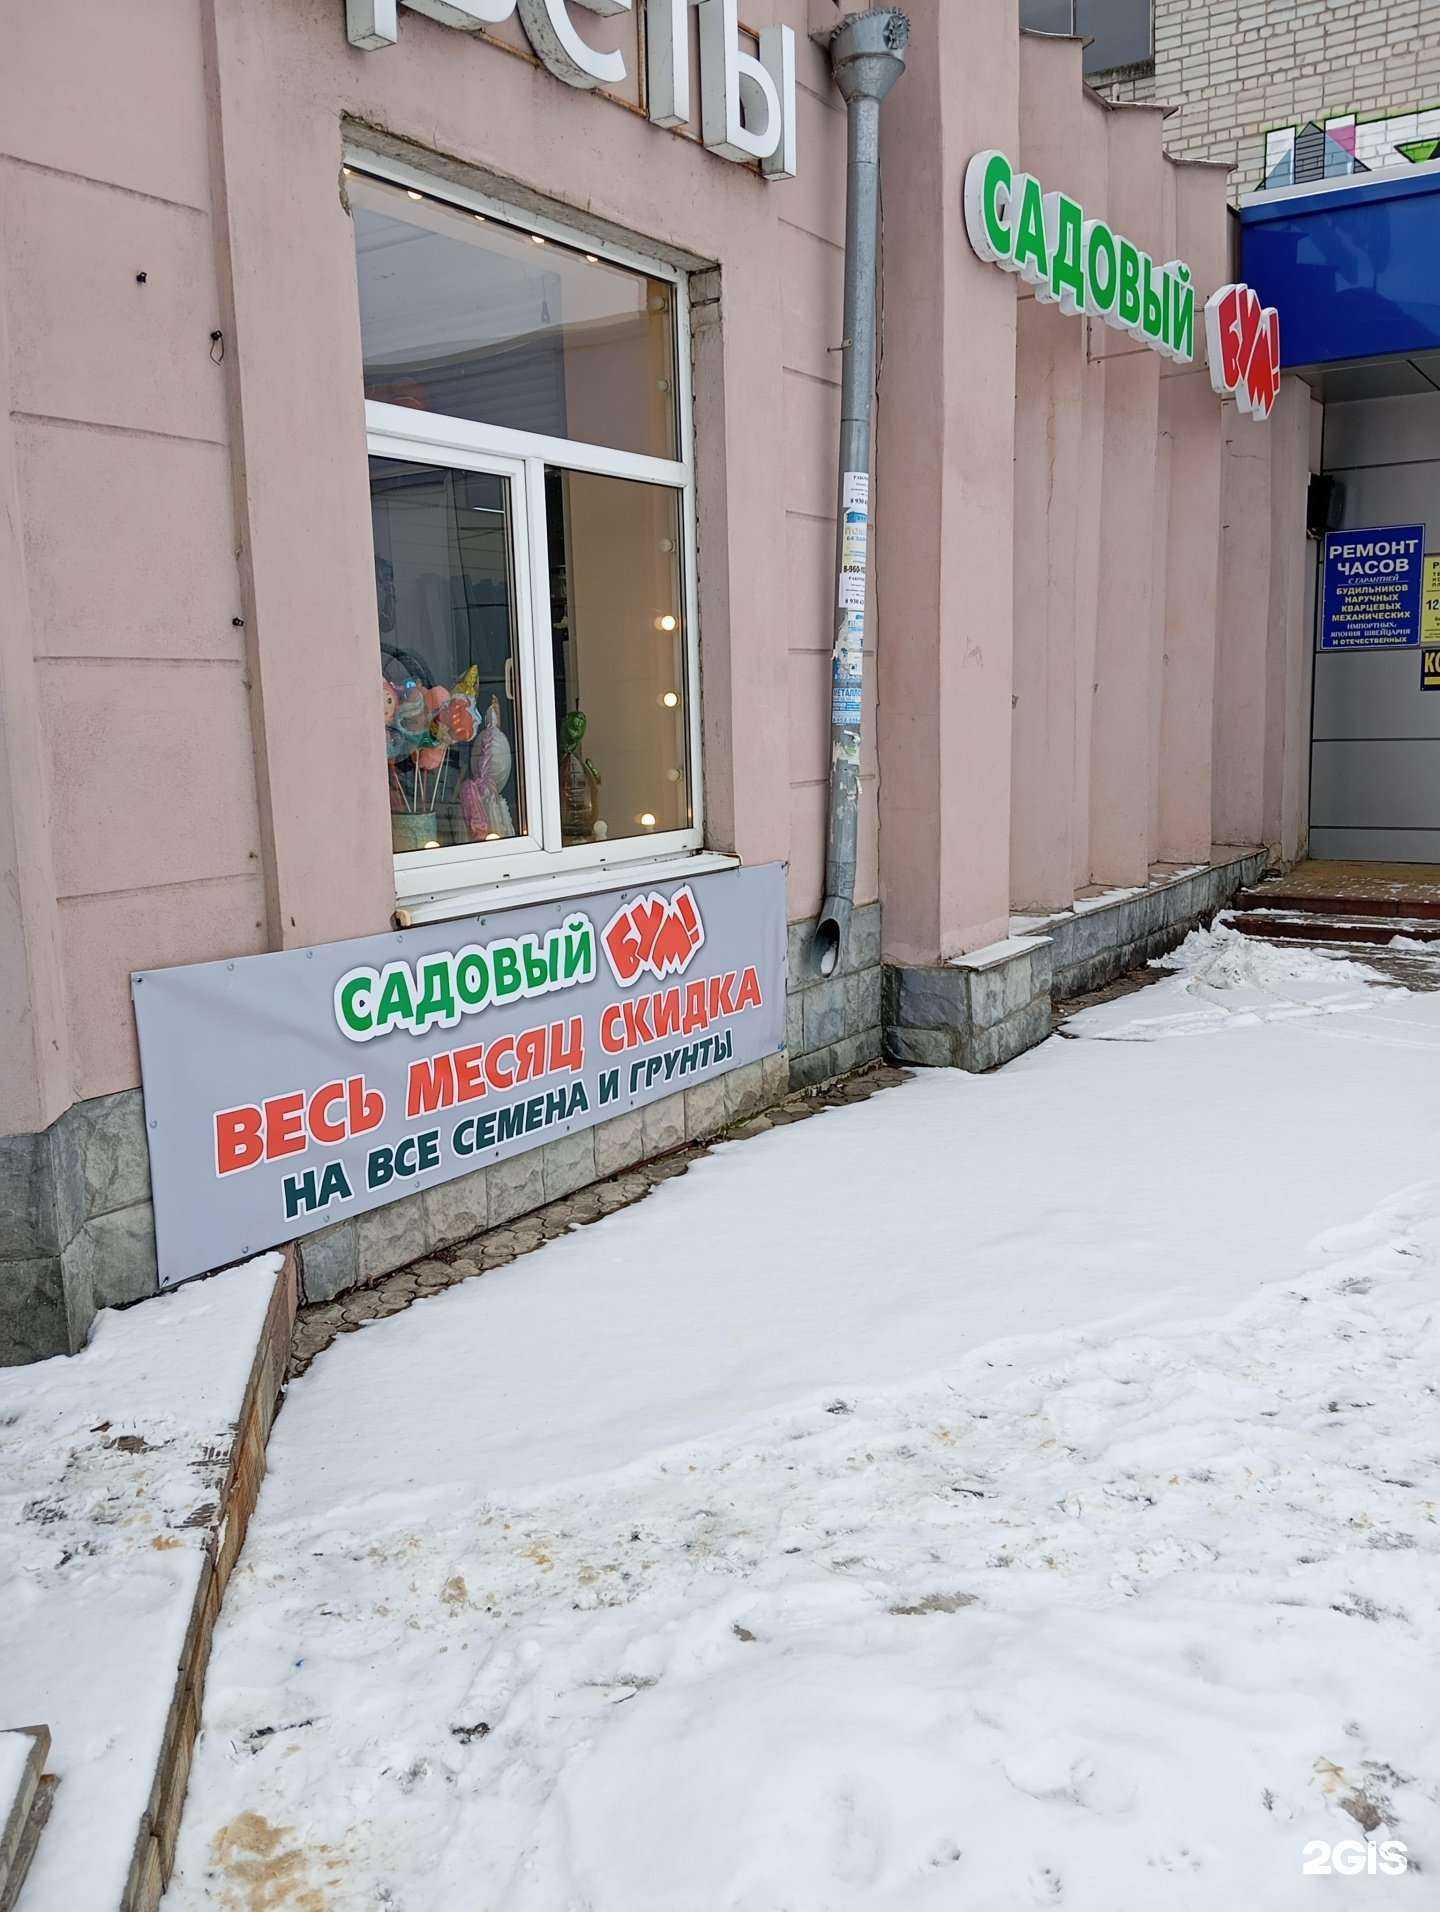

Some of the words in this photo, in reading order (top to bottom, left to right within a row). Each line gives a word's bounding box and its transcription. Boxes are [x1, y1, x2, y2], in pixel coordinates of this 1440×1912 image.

[980, 154, 1194, 359] САДОВЫЙ
[1329, 540, 1418, 559] РЕМОНТ
[1337, 558, 1409, 576] ЧАСОВ
[1336, 584, 1408, 595] БУДИЛЬНИКОВ
[1341, 602, 1402, 613] КВАРЦЕВЫХ
[1345, 594, 1399, 604] НАРУЧНЫХ
[1331, 611, 1411, 622] МЕХАНИЧЕСКИХ
[341, 921, 592, 1033] САДОВЫЙ
[606, 893, 700, 980] БУМ!
[215, 1075, 384, 1175] ВЕСЬ
[407, 1018, 584, 1117] МЕСЯЦ
[601, 967, 762, 1052] СКИДКА
[283, 1163, 352, 1218] НА
[367, 1131, 440, 1189] ВСЕ
[452, 1081, 589, 1157] СЕМЕНА
[599, 1068, 620, 1105] И
[629, 1030, 733, 1093] ГРУНТЫ
